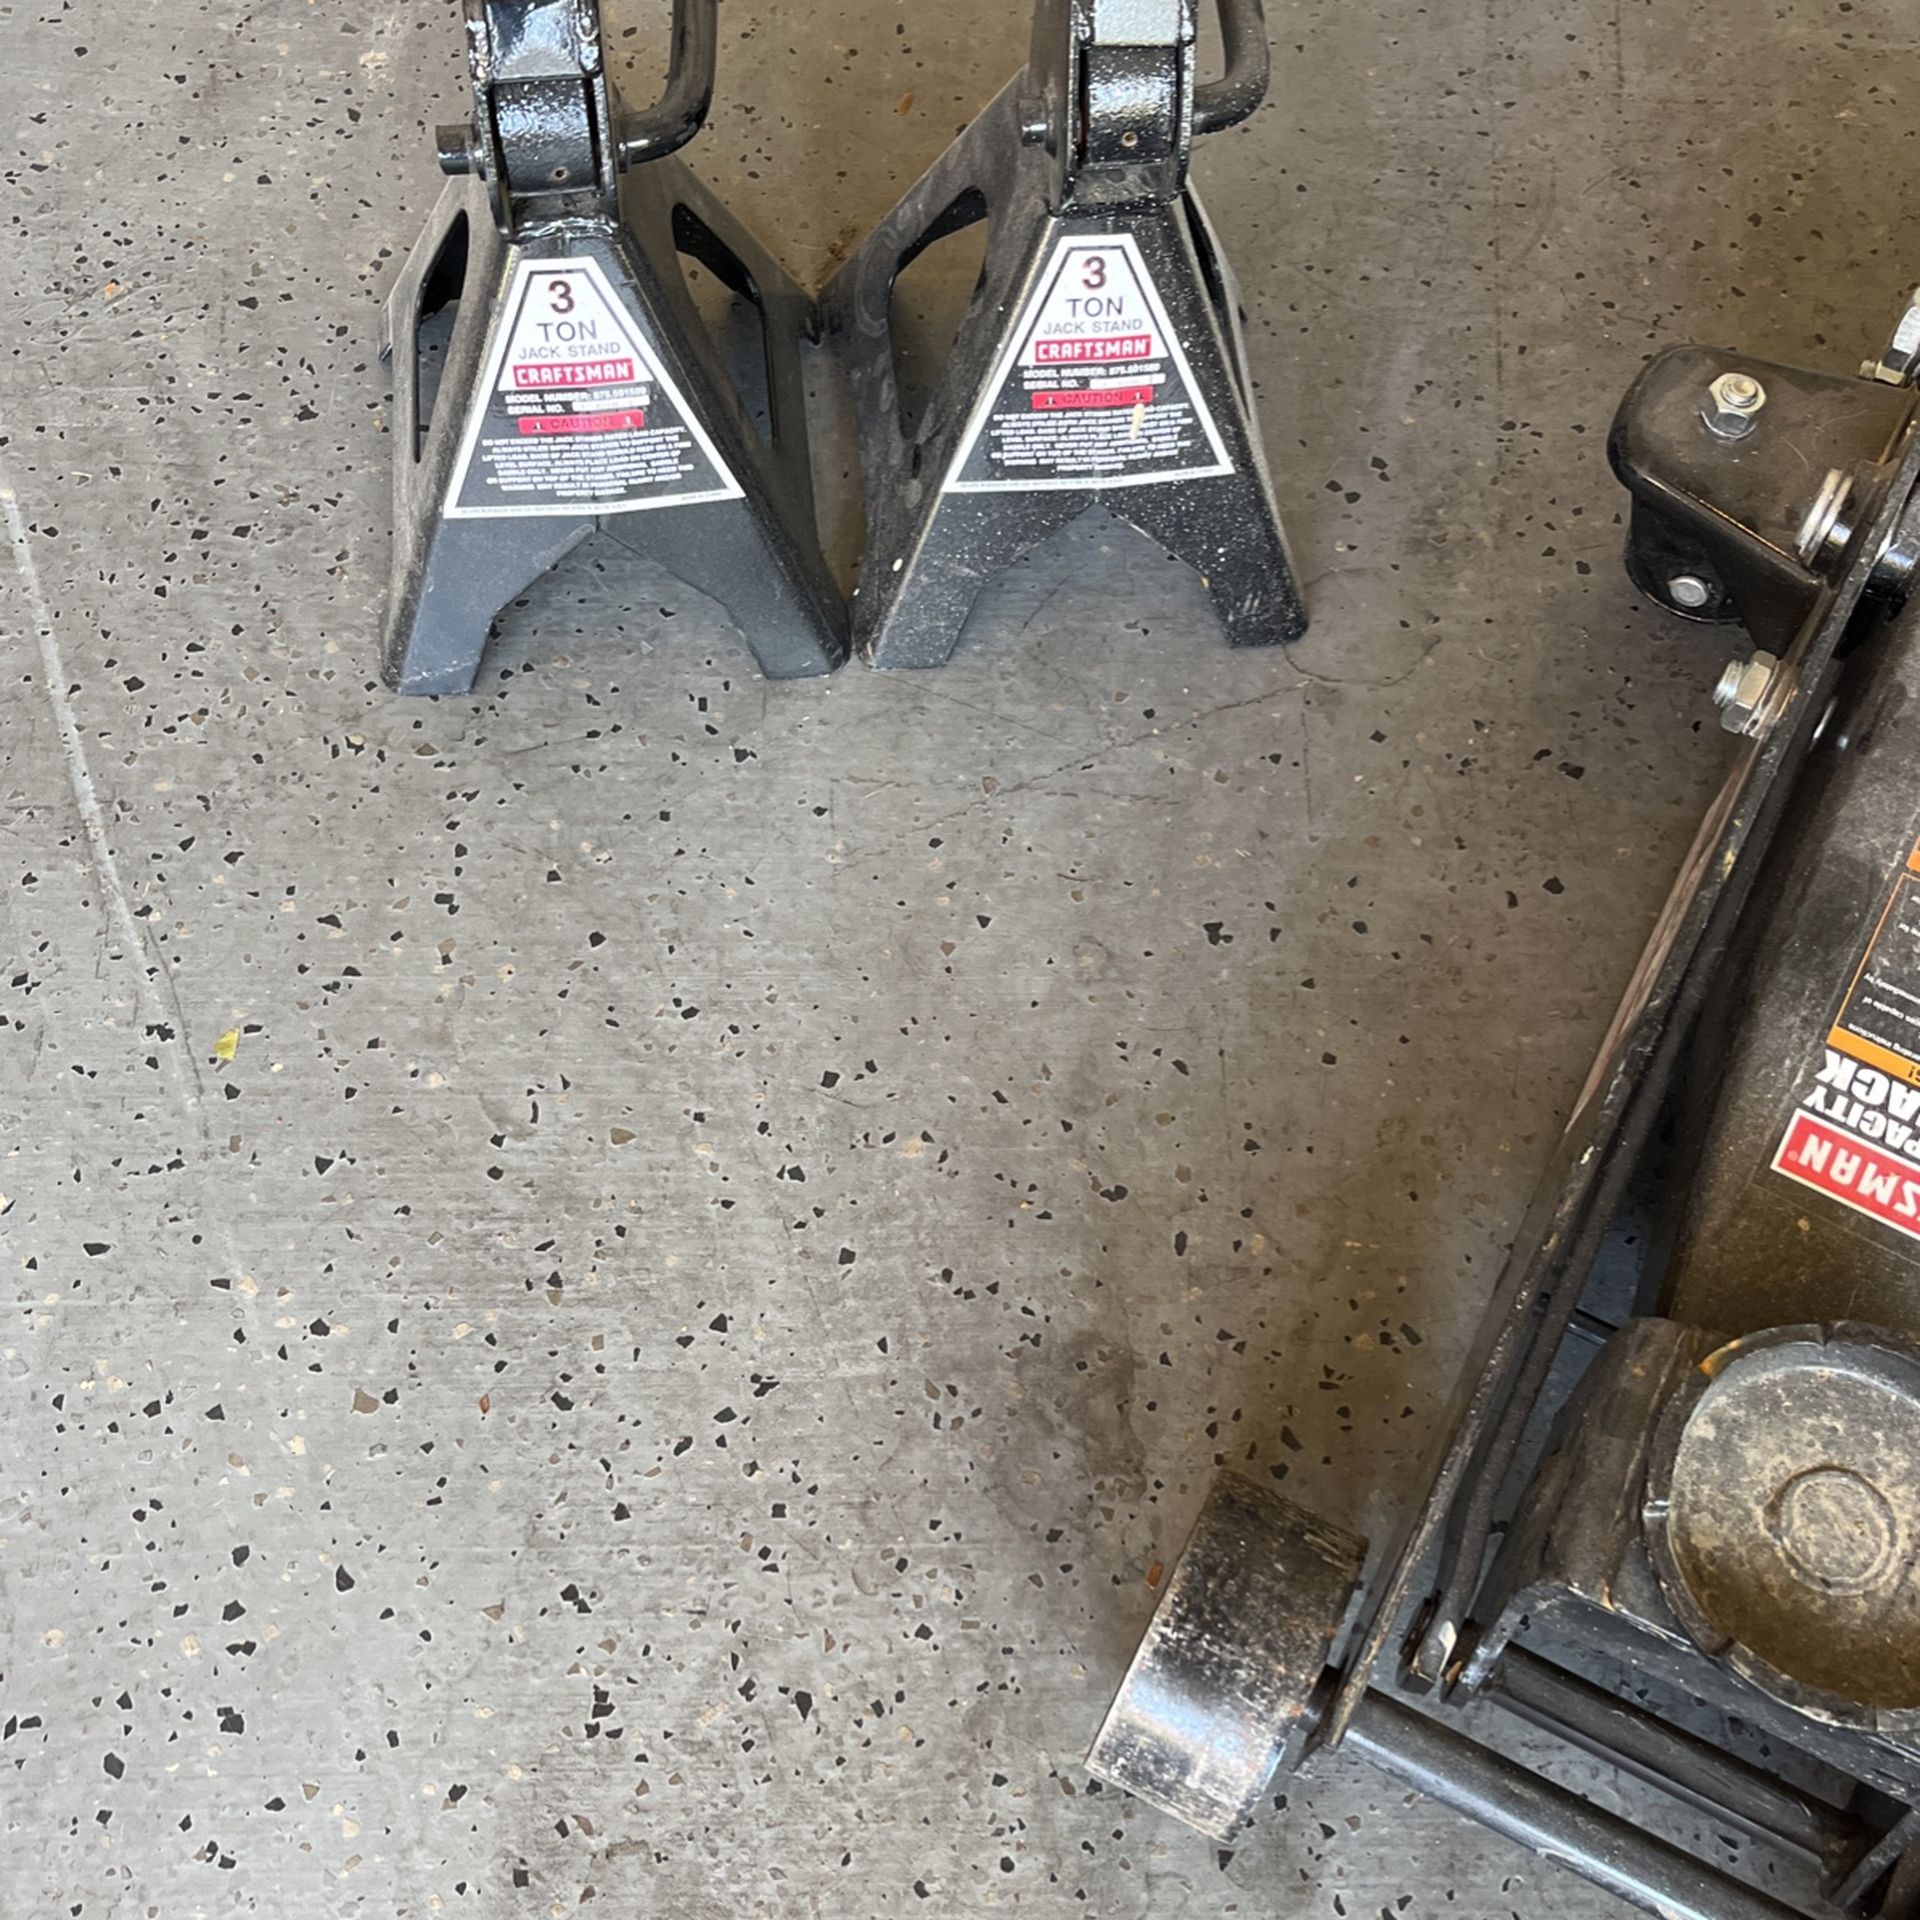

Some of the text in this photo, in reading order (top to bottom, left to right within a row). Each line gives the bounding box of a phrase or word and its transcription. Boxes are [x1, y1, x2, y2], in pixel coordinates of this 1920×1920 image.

[1082, 256, 1107, 290] 3
[548, 280, 575, 314] 3
[1065, 296, 1123, 318] TON
[536, 320, 598, 342] TON
[1043, 318, 1143, 335] JACK STAND
[518, 342, 622, 360] JACK STAND
[1037, 338, 1147, 360] CRAFTSMAN
[516, 362, 630, 385] CRAFTSMAN
[1024, 369, 1059, 378] MODEL
[1024, 379, 1079, 389] SERIAL NO.
[505, 394, 542, 403] MODEL
[1062, 391, 1123, 404] CAUTION
[508, 404, 565, 414] SERIAL NO.
[551, 415, 613, 430] CAUTION
[1814, 1050, 1920, 1129] ACK
[1797, 1134, 1920, 1221] SMAN
